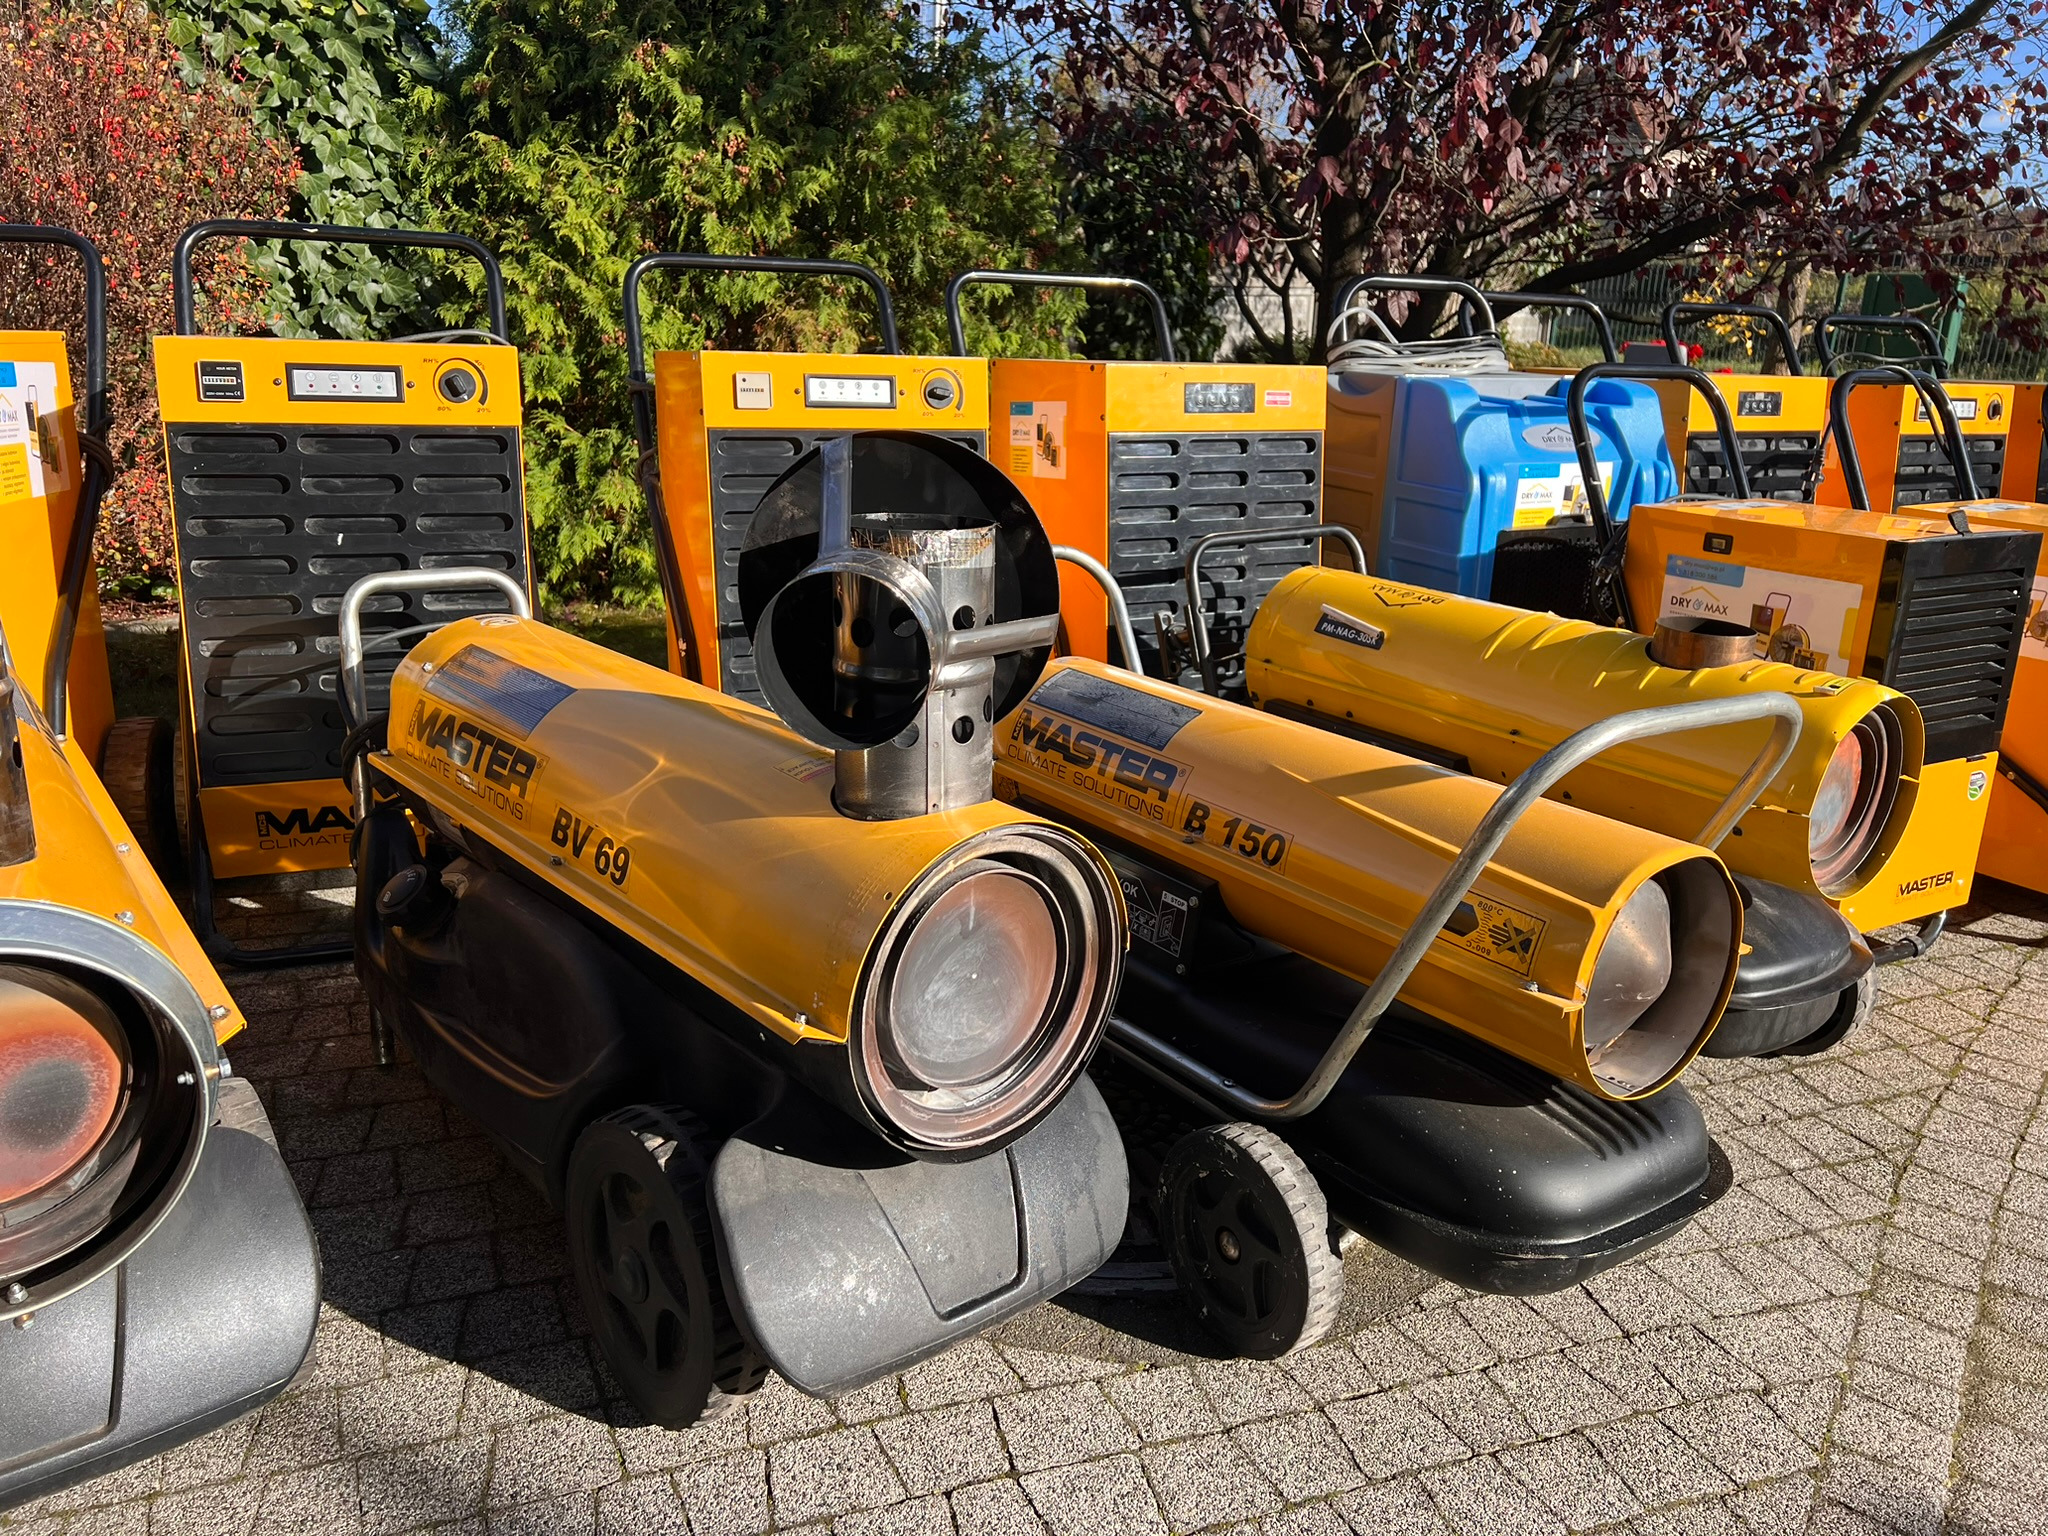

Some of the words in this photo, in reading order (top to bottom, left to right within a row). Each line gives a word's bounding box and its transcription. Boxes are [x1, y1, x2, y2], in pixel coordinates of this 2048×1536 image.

[7, 410, 19, 423] MAX
[1521, 491, 1534, 500] DRY
[1540, 491, 1553, 499] MAX
[1413, 595, 1446, 605] DRY
[1670, 595, 1692, 609] DRY
[1703, 602, 1729, 617] MAX
[408, 702, 422, 738] MCS
[1013, 711, 1028, 738] MCS
[416, 698, 538, 800] MASTER
[1019, 708, 1178, 803] MASTER
[406, 741, 450, 779] CLIMATE
[455, 769, 524, 821] SOLUTIONS
[1007, 743, 1068, 780] CLIMATE
[1072, 771, 1164, 821] SOLUTIONS
[258, 814, 268, 835] MCS
[1183, 800, 1211, 835] B
[1222, 816, 1286, 868] 150
[259, 833, 353, 851] CLIMATE
[551, 807, 595, 859] BV
[594, 836, 630, 886] 69
[1898, 870, 1954, 896] MASTER
[1170, 896, 1186, 908] STOP
[1477, 900, 1504, 916] 800°C
[1465, 940, 1492, 957] 800°C
